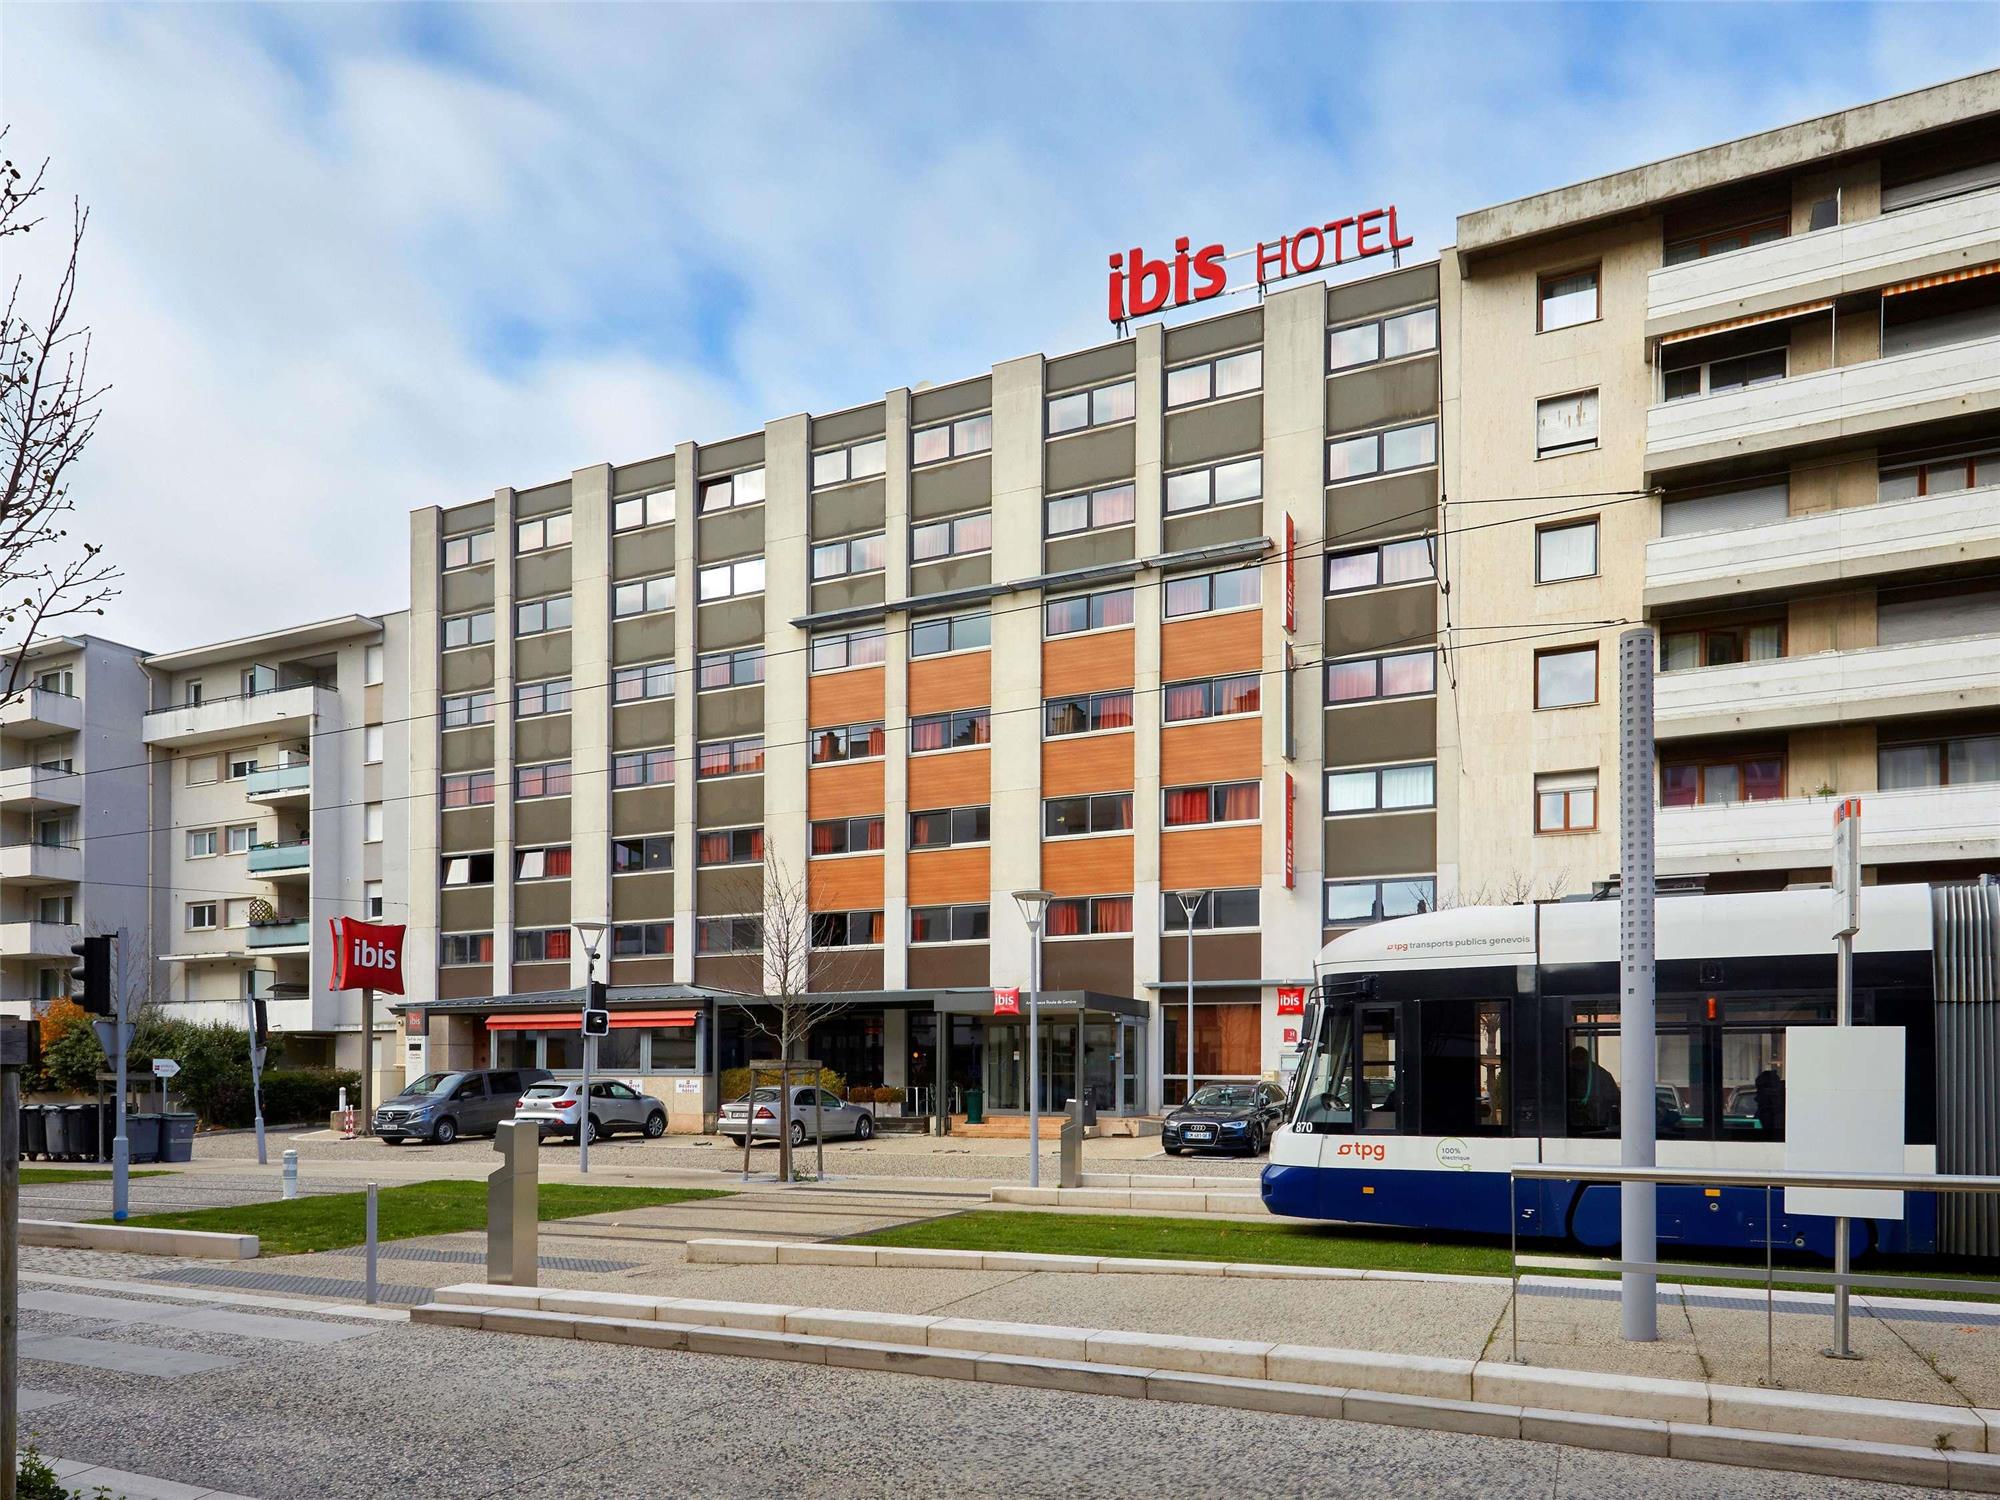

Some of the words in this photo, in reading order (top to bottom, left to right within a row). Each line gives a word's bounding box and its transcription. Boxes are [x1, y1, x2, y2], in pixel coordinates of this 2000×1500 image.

[1108, 236, 1227, 324] ibis
[1256, 205, 1414, 284] HOTEL
[1410, 940, 1453, 950] transports
[1455, 937, 1487, 947] publics
[1489, 936, 1530, 946] genevois
[354, 938, 396, 970] ibis
[995, 993, 1015, 1006] ibis
[1280, 994, 1300, 1006] ibis
[1296, 1121, 1313, 1133] 870
[1355, 1142, 1385, 1161] tpg
